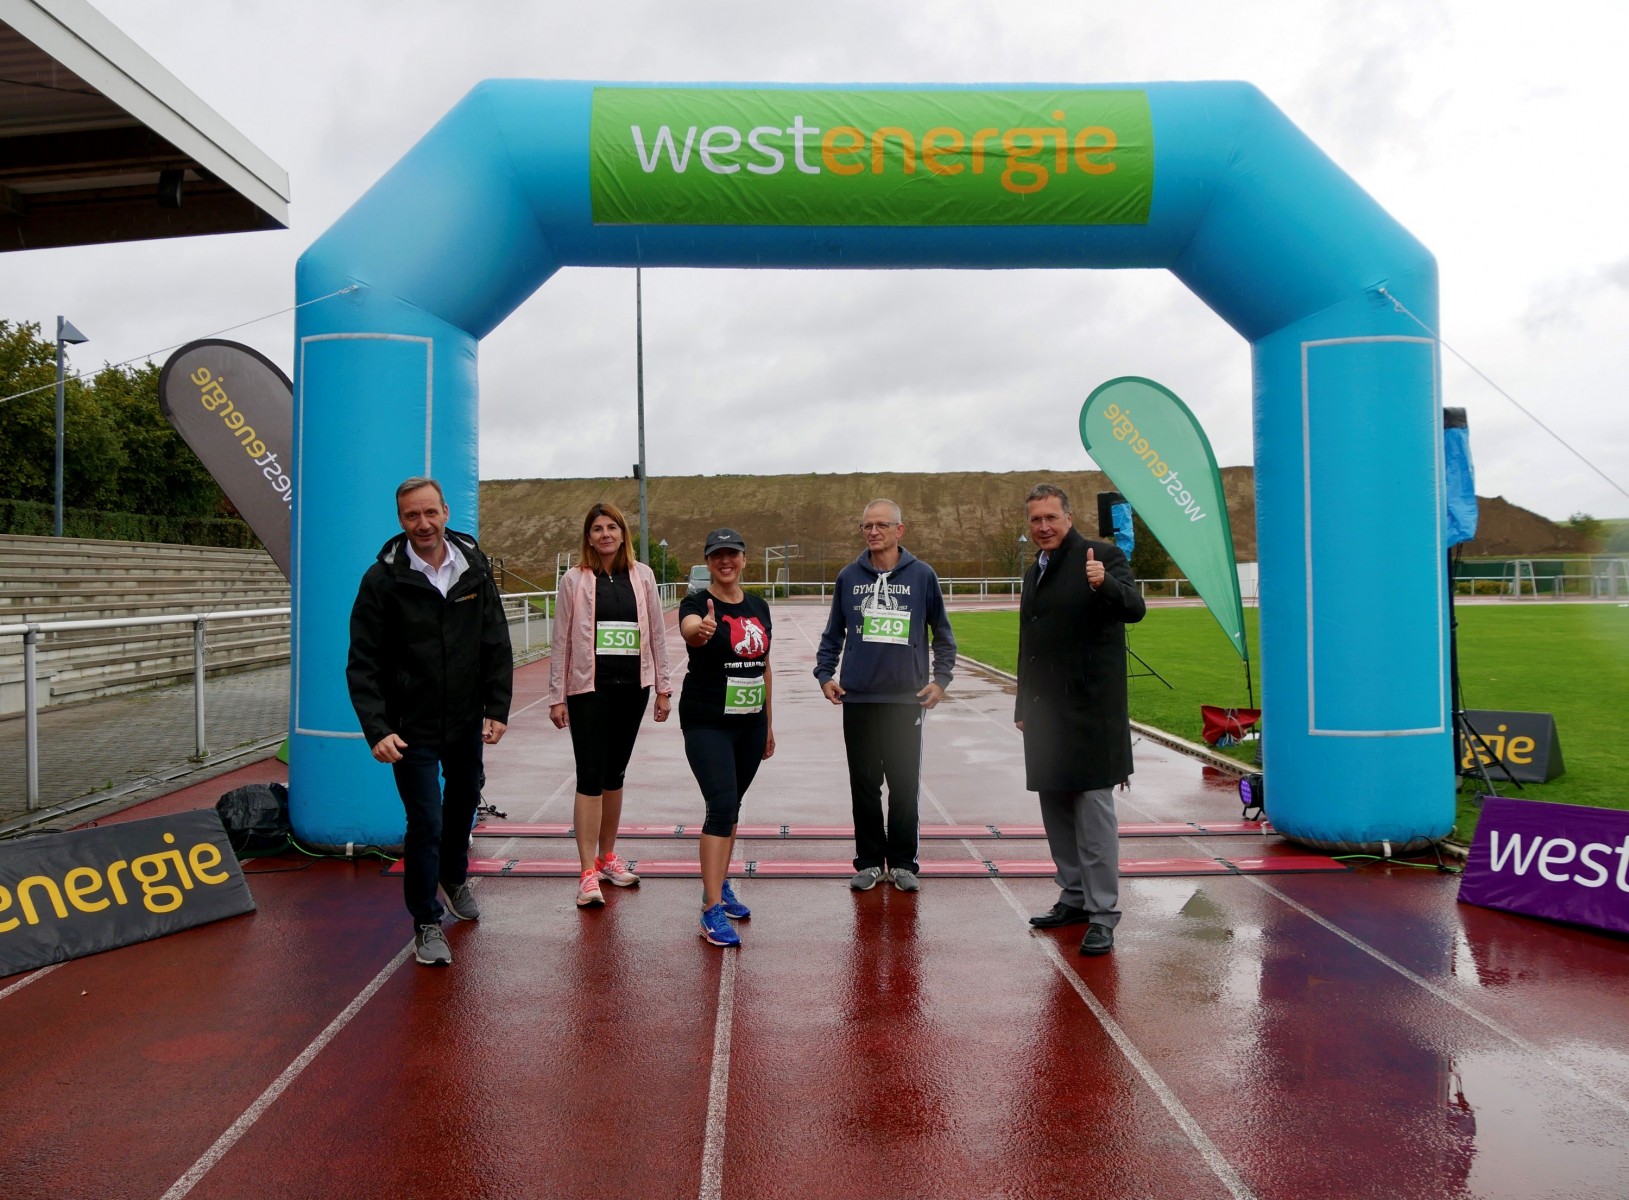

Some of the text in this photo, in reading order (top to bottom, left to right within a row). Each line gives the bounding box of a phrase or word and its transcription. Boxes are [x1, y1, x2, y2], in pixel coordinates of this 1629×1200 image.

[630, 109, 1118, 194] westenergie
[869, 619, 904, 635] 549
[602, 631, 635, 647] 550
[734, 687, 762, 705] 551
